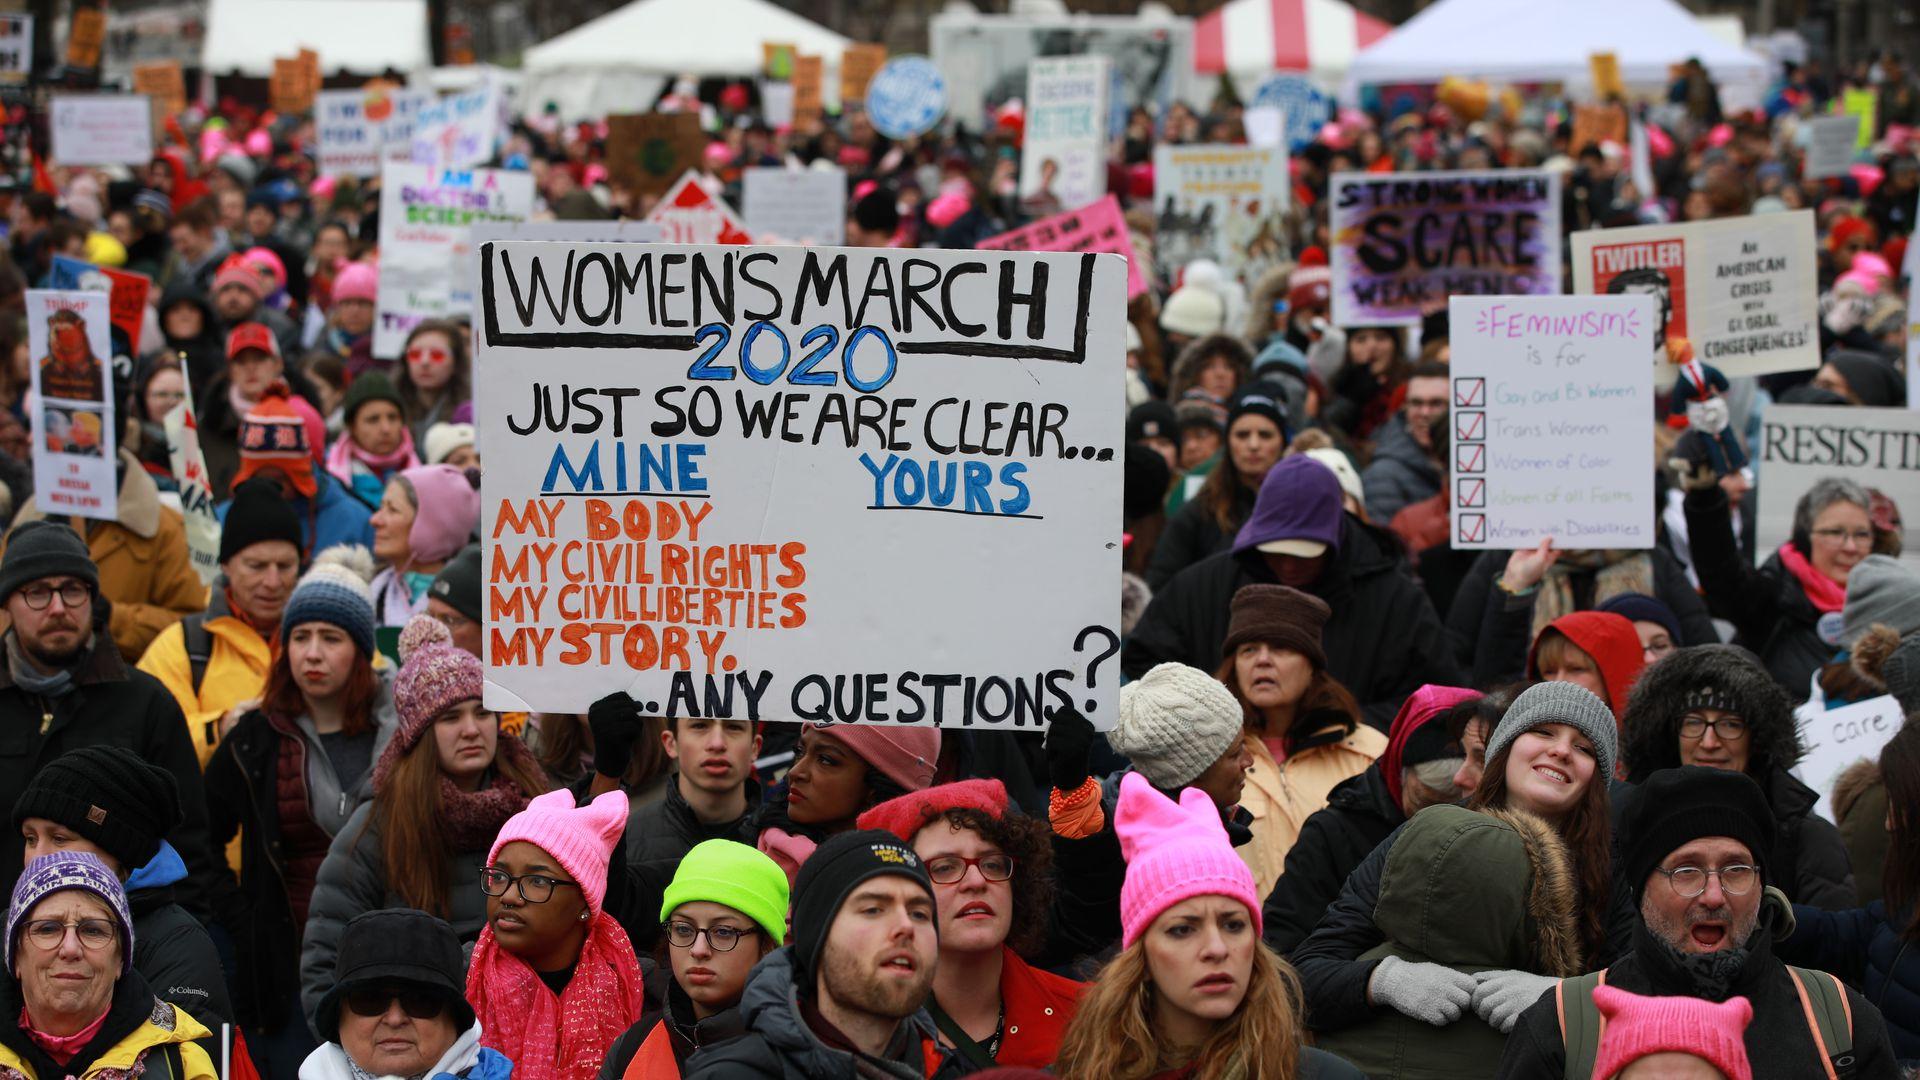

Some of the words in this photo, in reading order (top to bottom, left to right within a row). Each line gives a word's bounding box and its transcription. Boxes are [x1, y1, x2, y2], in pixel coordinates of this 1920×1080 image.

[442, 169, 474, 186] AM
[1356, 211, 1540, 273] SCARE
[1594, 241, 1683, 274] TWITLER
[1716, 257, 1786, 279] AMERICAN
[500, 249, 783, 328] WOMEN'S
[790, 250, 1050, 341] MARCH
[1730, 281, 1773, 299] CRISIS
[1490, 304, 1626, 338] FEMINISM
[1728, 313, 1781, 334] GLOBAL
[686, 321, 899, 394] 2020
[1526, 344, 1543, 366] is
[1555, 341, 1586, 368] for
[1704, 324, 1810, 359] CONSEQUENCES!
[1495, 382, 1526, 407] Gay
[1533, 387, 1560, 402] and
[1566, 382, 1583, 400] Bi
[1587, 384, 1637, 398] Women
[506, 382, 641, 438] JUST
[650, 385, 723, 438] SO
[735, 390, 811, 444] WE
[811, 393, 917, 451] ARE
[923, 397, 1115, 462] CLEAR...
[1493, 418, 1542, 440] Trans
[1549, 420, 1609, 436] Women
[540, 439, 709, 492] MINE
[1491, 452, 1552, 471] Women
[1555, 452, 1572, 470] of
[1579, 453, 1612, 468] Color
[858, 452, 1031, 515] YOURS
[492, 498, 566, 539] MY
[585, 499, 714, 541] BODY
[1486, 519, 1535, 539] Women
[1566, 519, 1641, 537] Disabilities
[490, 541, 558, 584] MY
[561, 540, 654, 584] CIVIL
[660, 541, 808, 591] RIGHTS
[490, 585, 549, 623] MY
[490, 627, 555, 667] MY
[559, 622, 738, 675] STORY.
[791, 625, 1121, 728] QUESTIONS?
[1832, 713, 1889, 744] care
[176, 986, 209, 998] Columbia
